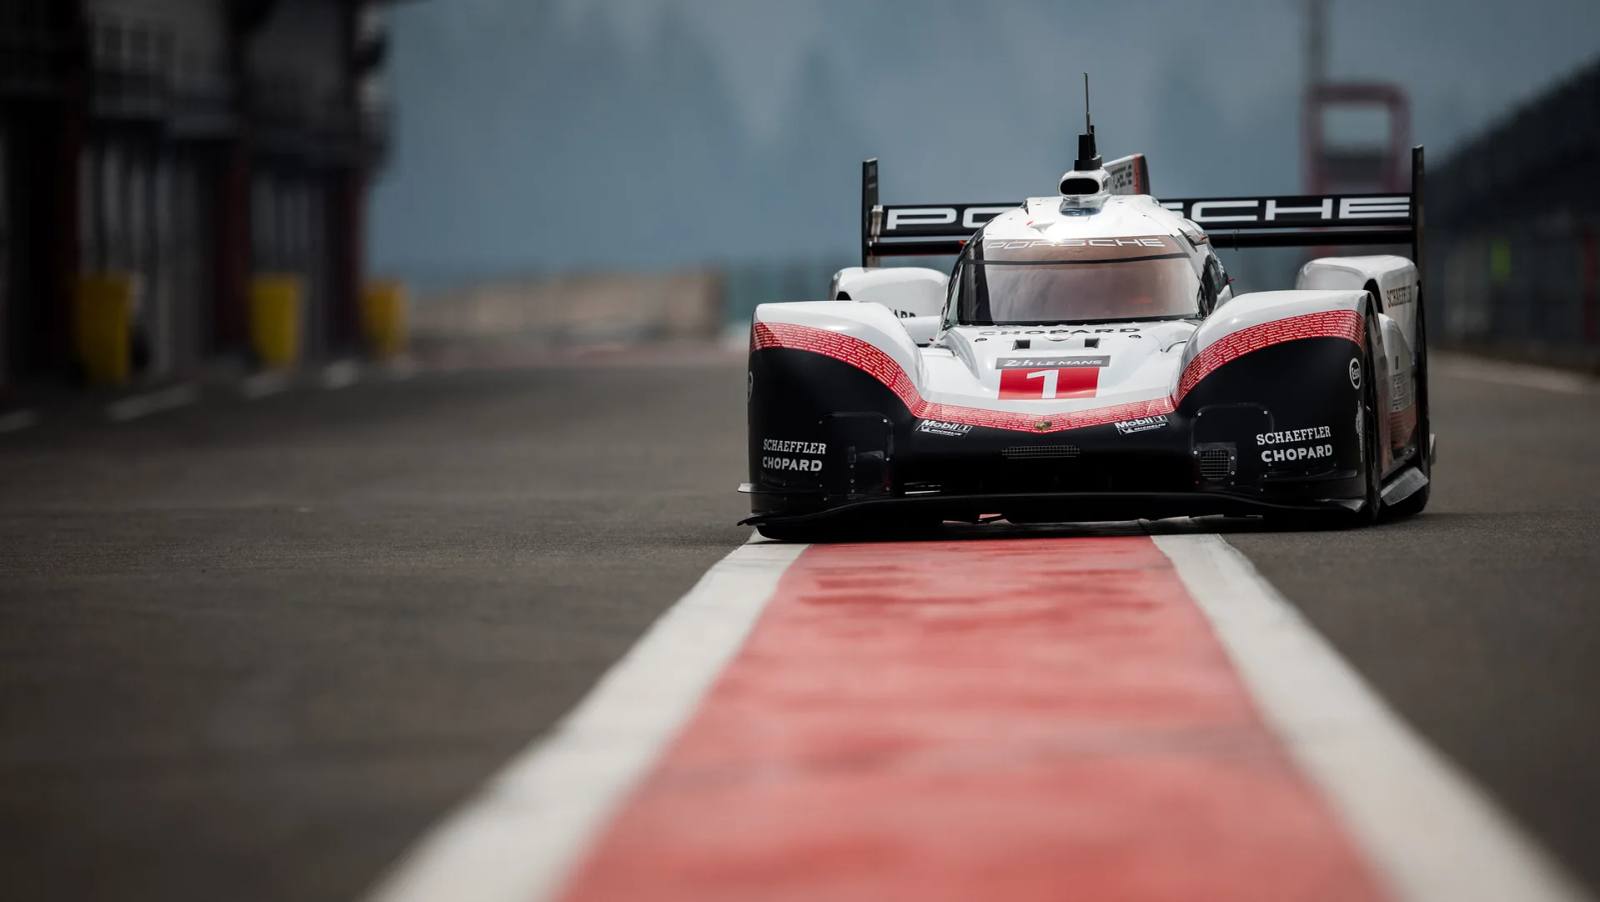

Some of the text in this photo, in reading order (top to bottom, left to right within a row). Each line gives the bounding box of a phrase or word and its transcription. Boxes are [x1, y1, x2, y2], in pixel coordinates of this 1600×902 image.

[886, 196, 1410, 230] POCHE
[979, 327, 1141, 336] CHOPARD
[1026, 369, 1060, 399] 1
[921, 419, 960, 431] Mobil
[1114, 416, 1154, 429] Mobil
[1256, 426, 1332, 446] SCHAEFFLER
[763, 438, 827, 455] SCHAEFFLER
[1261, 444, 1333, 462] CHOPARD
[762, 456, 823, 472] CHOPARD
